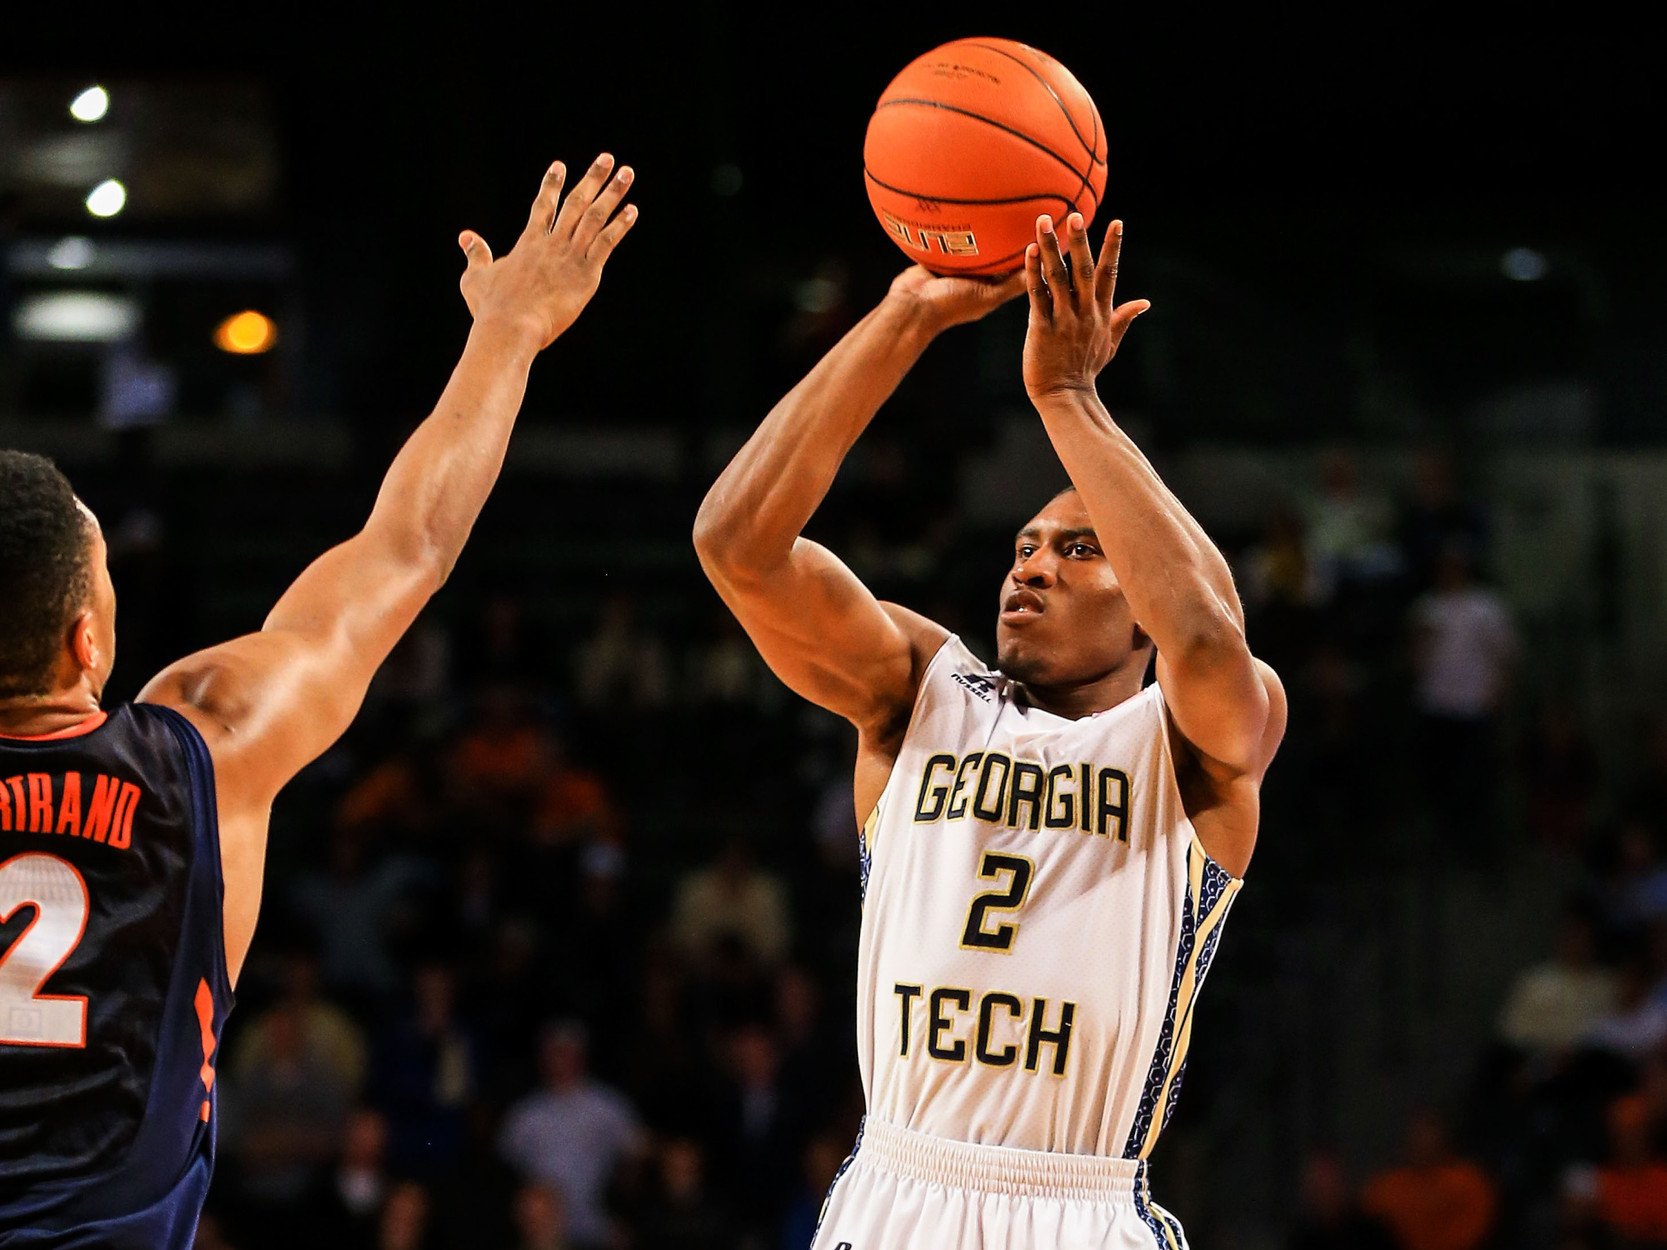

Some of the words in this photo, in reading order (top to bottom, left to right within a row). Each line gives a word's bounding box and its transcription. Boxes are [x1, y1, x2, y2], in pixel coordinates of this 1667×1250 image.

[950, 673, 991, 703] RUSSELL
[914, 751, 1131, 844] GEORGIA
[0, 851, 90, 1048] 2
[959, 851, 1034, 954] 2
[894, 983, 1077, 1077] TECH
